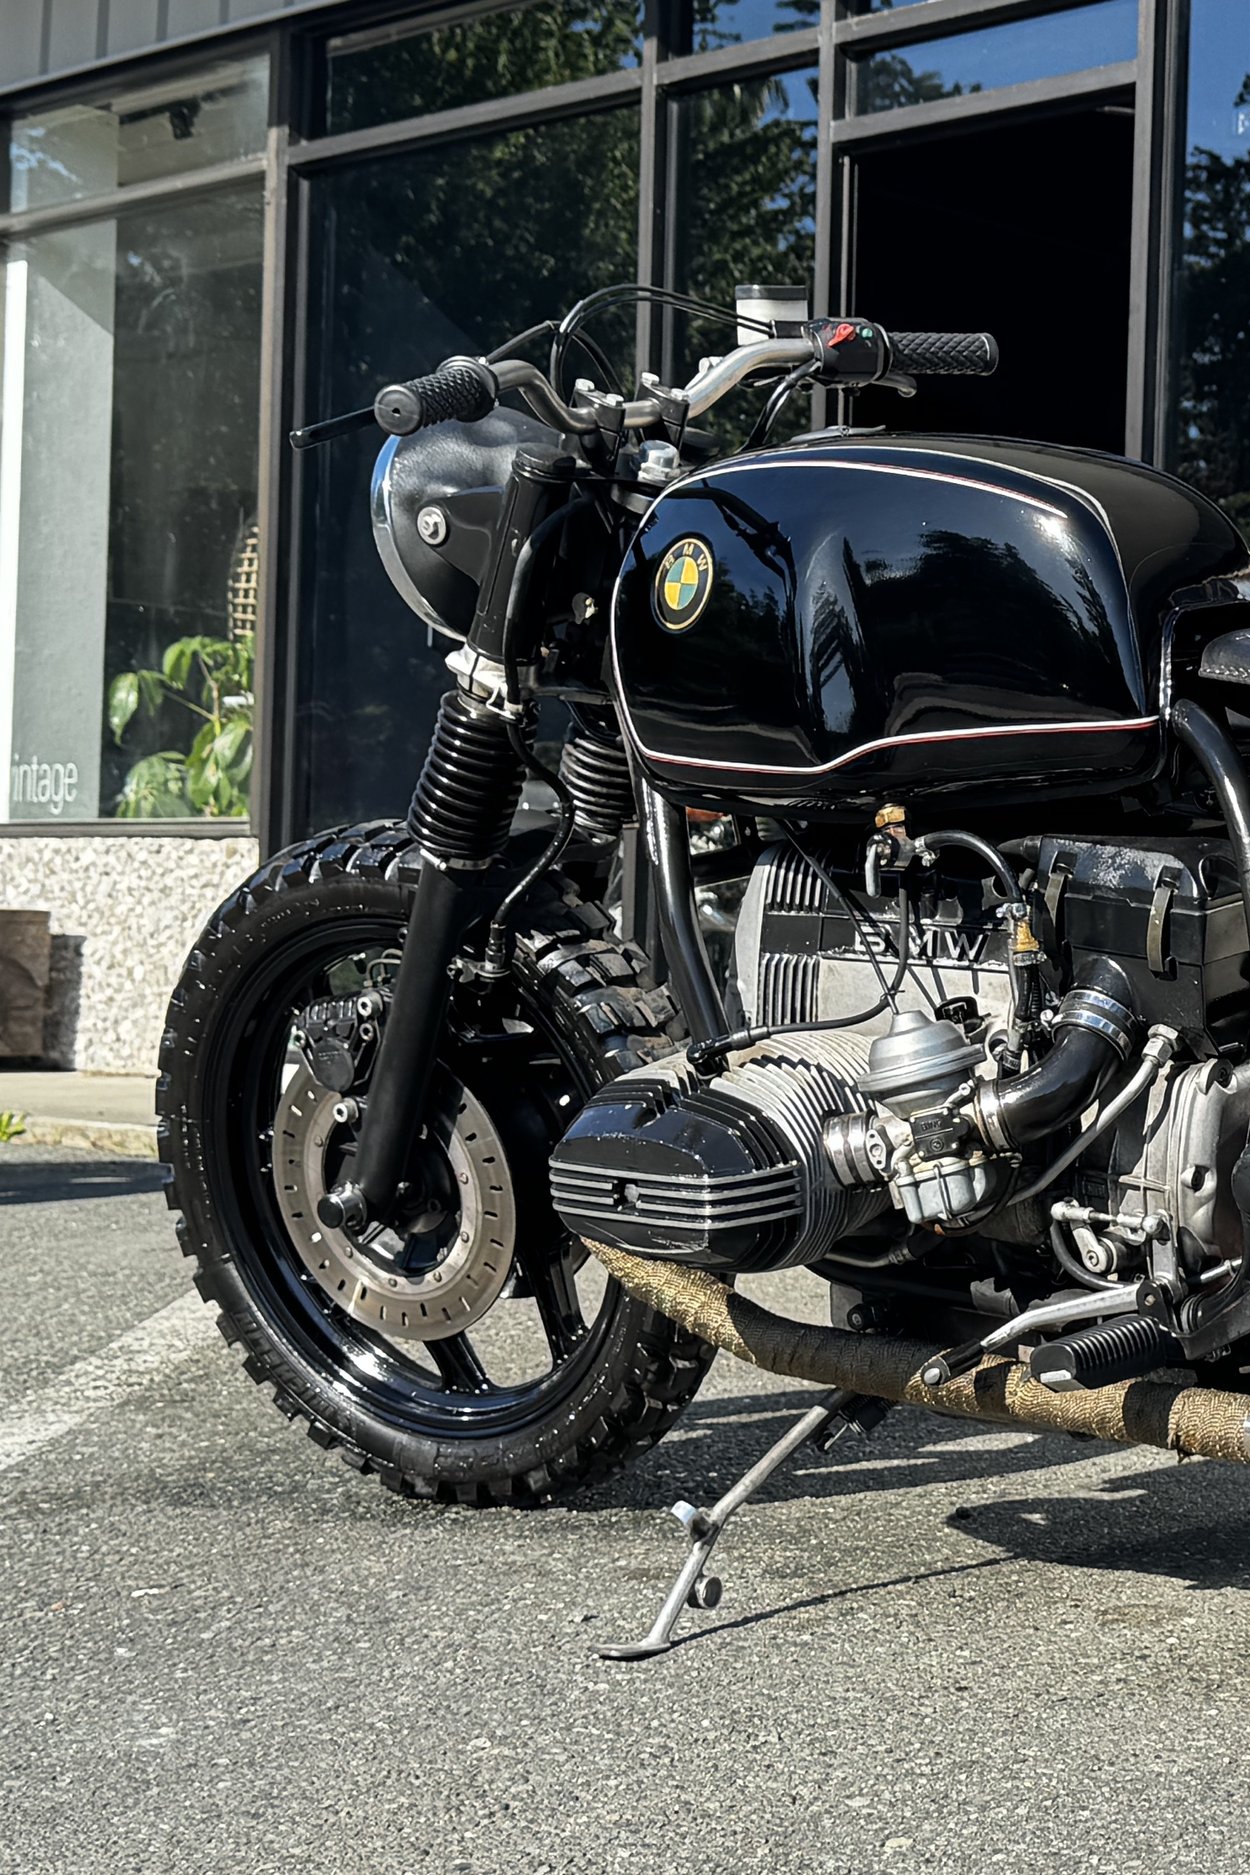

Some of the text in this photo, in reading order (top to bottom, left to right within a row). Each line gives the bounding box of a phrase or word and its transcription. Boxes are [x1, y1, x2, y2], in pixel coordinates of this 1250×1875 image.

[663, 543, 708, 571] BMW
[12, 752, 79, 816] intage
[854, 922, 985, 960] BMW
